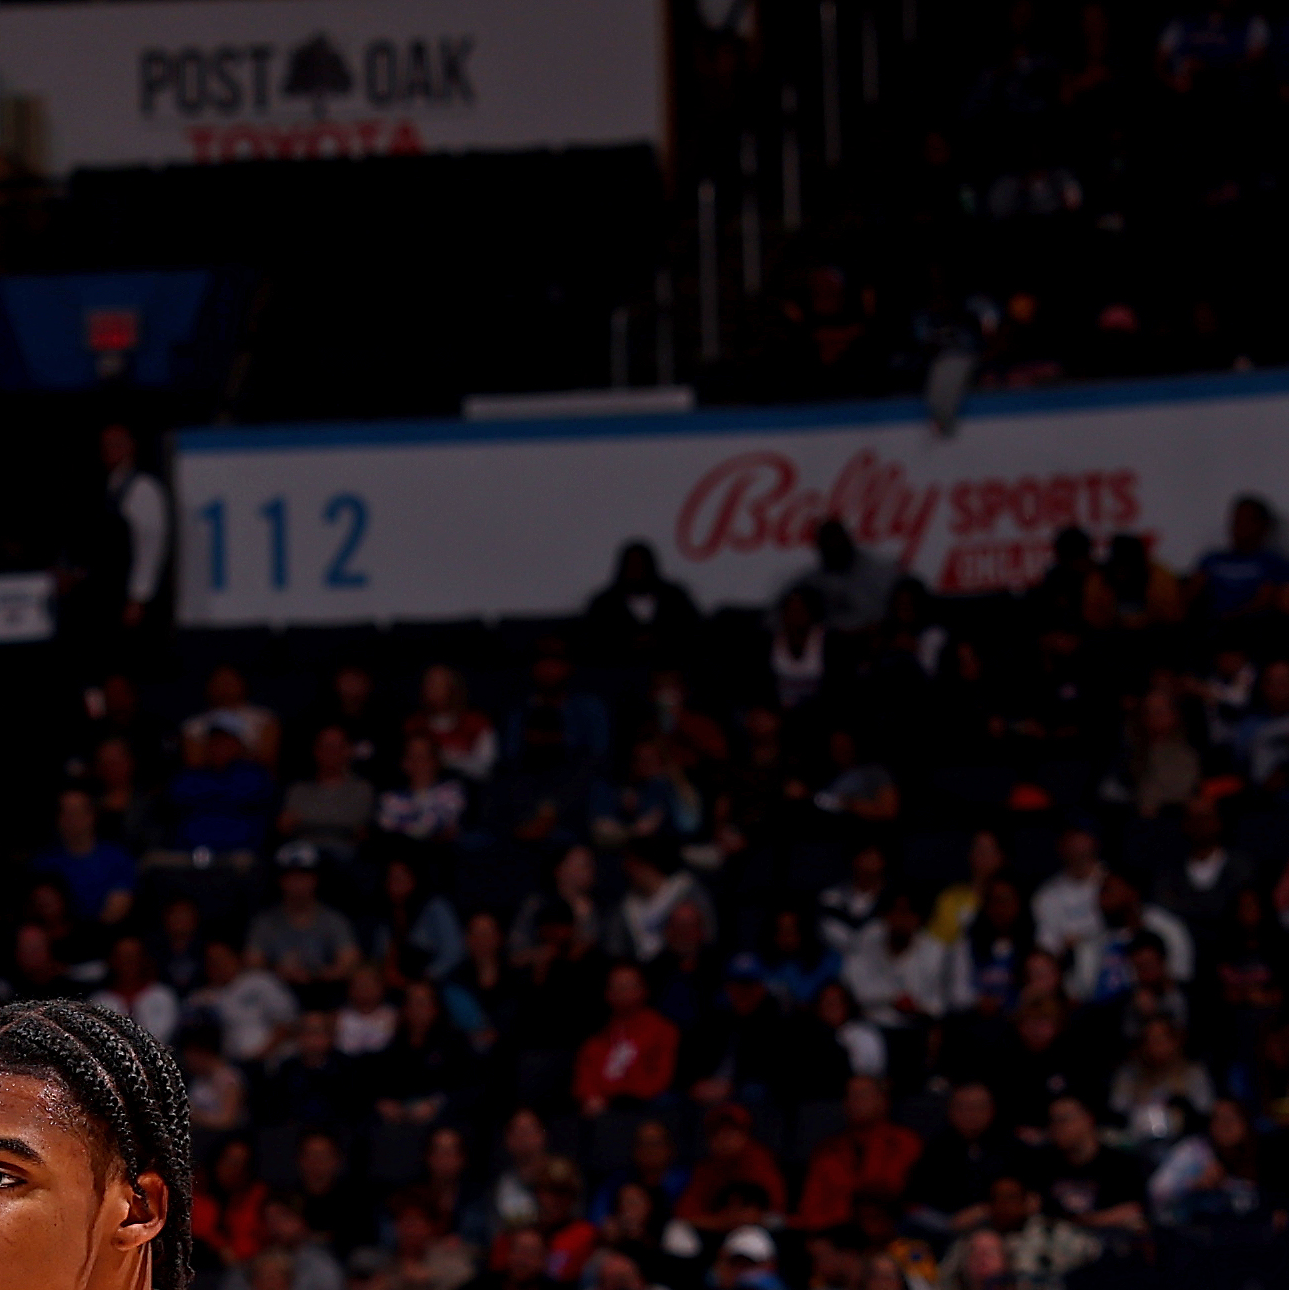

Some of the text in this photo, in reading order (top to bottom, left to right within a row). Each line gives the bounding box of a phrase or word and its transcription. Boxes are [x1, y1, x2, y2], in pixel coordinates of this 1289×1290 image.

[138, 35, 476, 116] POST OAK
[184, 119, 424, 167] TOYOTA
[199, 494, 369, 591] 112
[675, 449, 948, 574] Bally
[947, 469, 1141, 534] SPORTS
